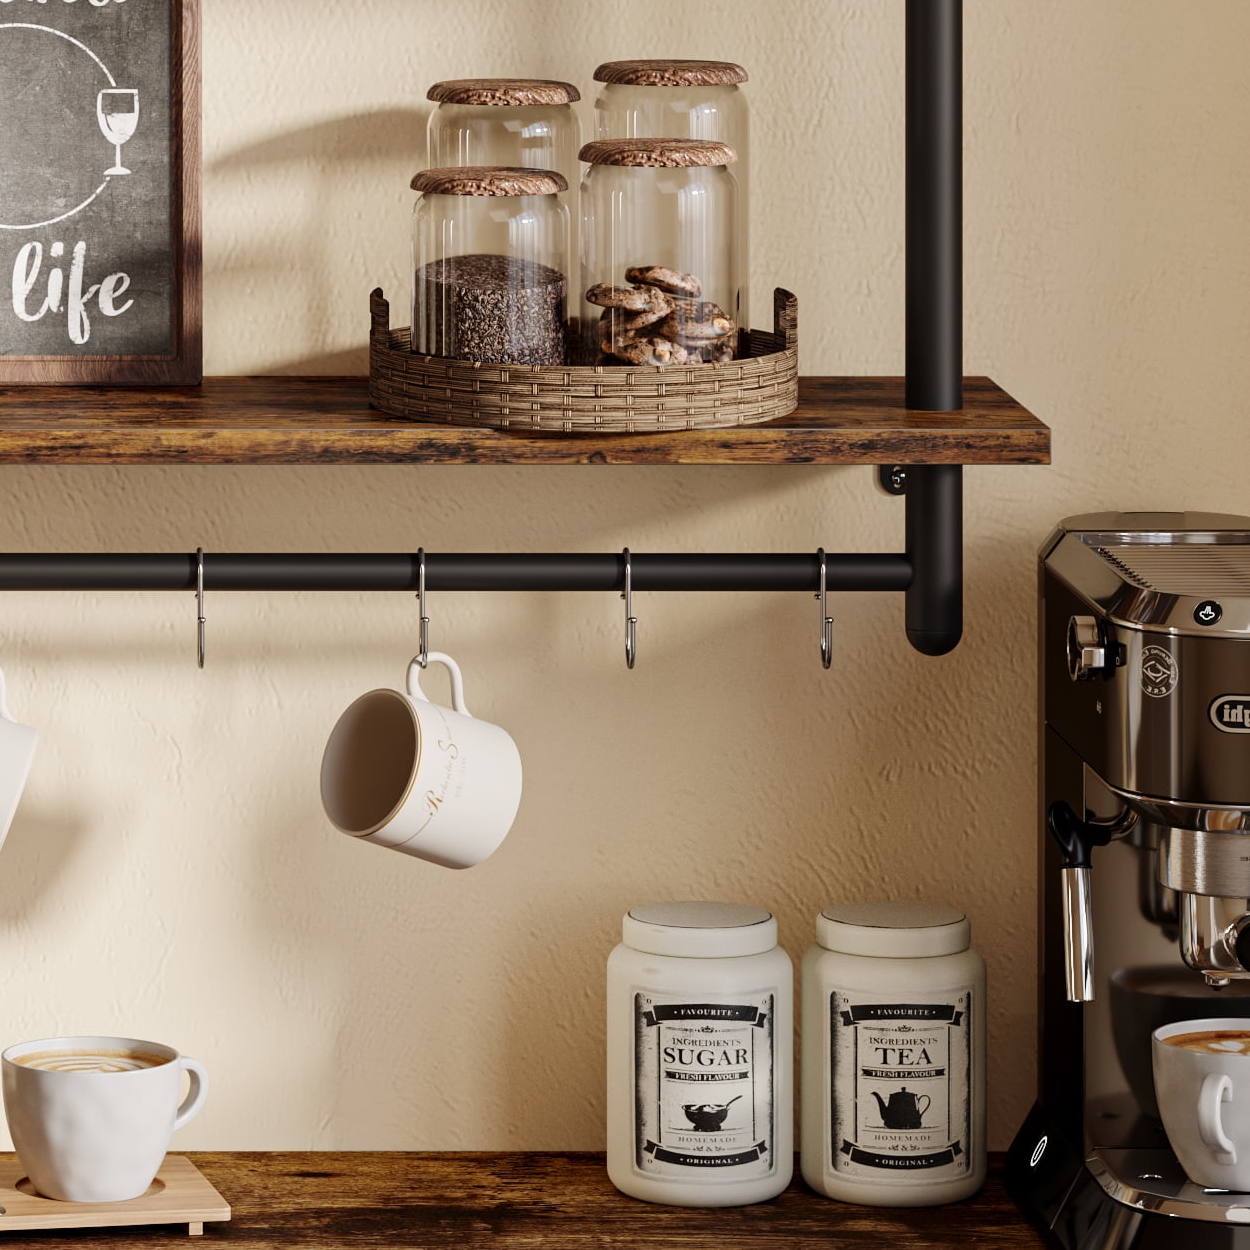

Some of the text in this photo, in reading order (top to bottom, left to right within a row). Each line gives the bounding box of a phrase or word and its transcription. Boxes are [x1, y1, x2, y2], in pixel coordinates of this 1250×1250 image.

[11, 240, 134, 345] life
[672, 1037, 741, 1047] INGREDIENTS
[869, 1037, 938, 1045] INGREDIENTS
[663, 1047, 749, 1066] SUGAR
[874, 1047, 933, 1065] TEA
[675, 1072, 740, 1081] FRESH FLAVOUR
[872, 1070, 936, 1078] FRESH FLAVOUR
